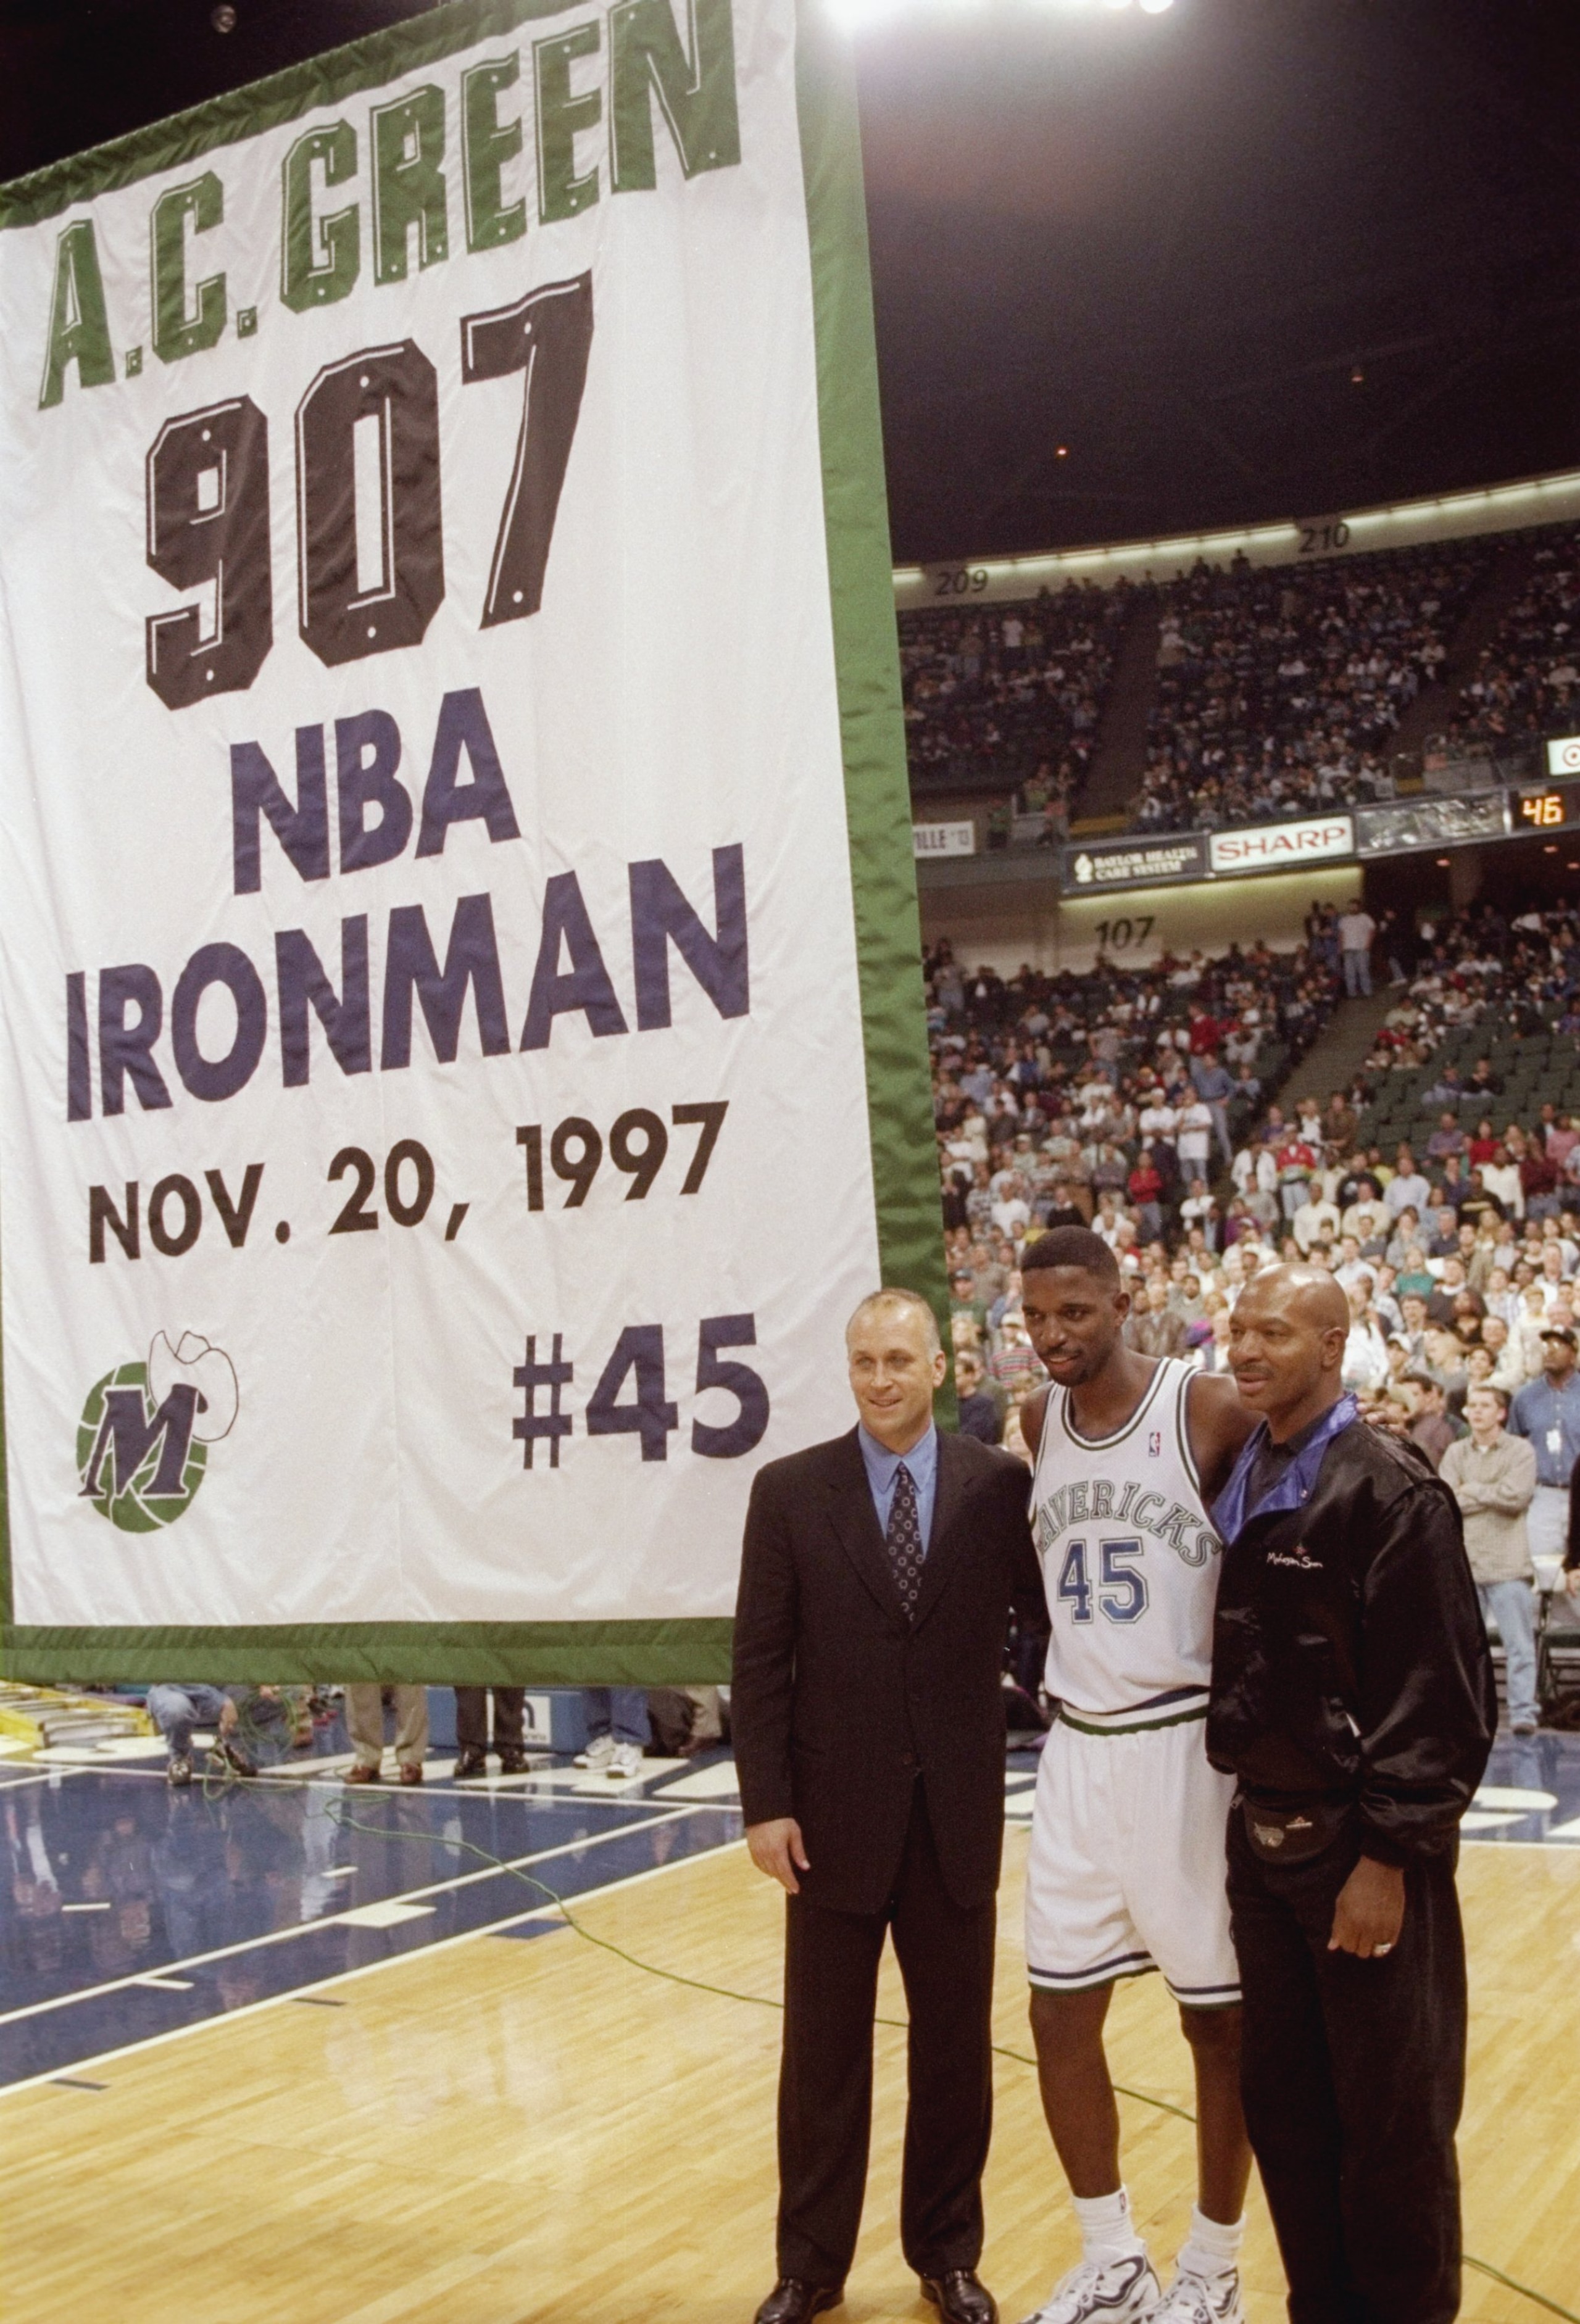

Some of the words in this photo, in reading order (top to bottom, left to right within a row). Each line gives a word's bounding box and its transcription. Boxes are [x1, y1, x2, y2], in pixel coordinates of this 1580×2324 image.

[38, 170, 257, 410] A.C.
[280, 0, 741, 313] GREEN
[146, 269, 594, 710] 907
[1299, 522, 1350, 552] 210
[934, 568, 989, 596] 209
[230, 686, 522, 895] NBA
[1217, 826, 1346, 860] SHARP
[1523, 795, 1564, 826] 46
[65, 842, 750, 1123] IRONMAN
[1095, 915, 1155, 950] 107
[89, 1163, 291, 1264] NOV.
[327, 1139, 470, 1242] 20,
[515, 1100, 730, 1212] 1997
[512, 1312, 771, 1471] #45
[1057, 1536, 1149, 1624] 45
